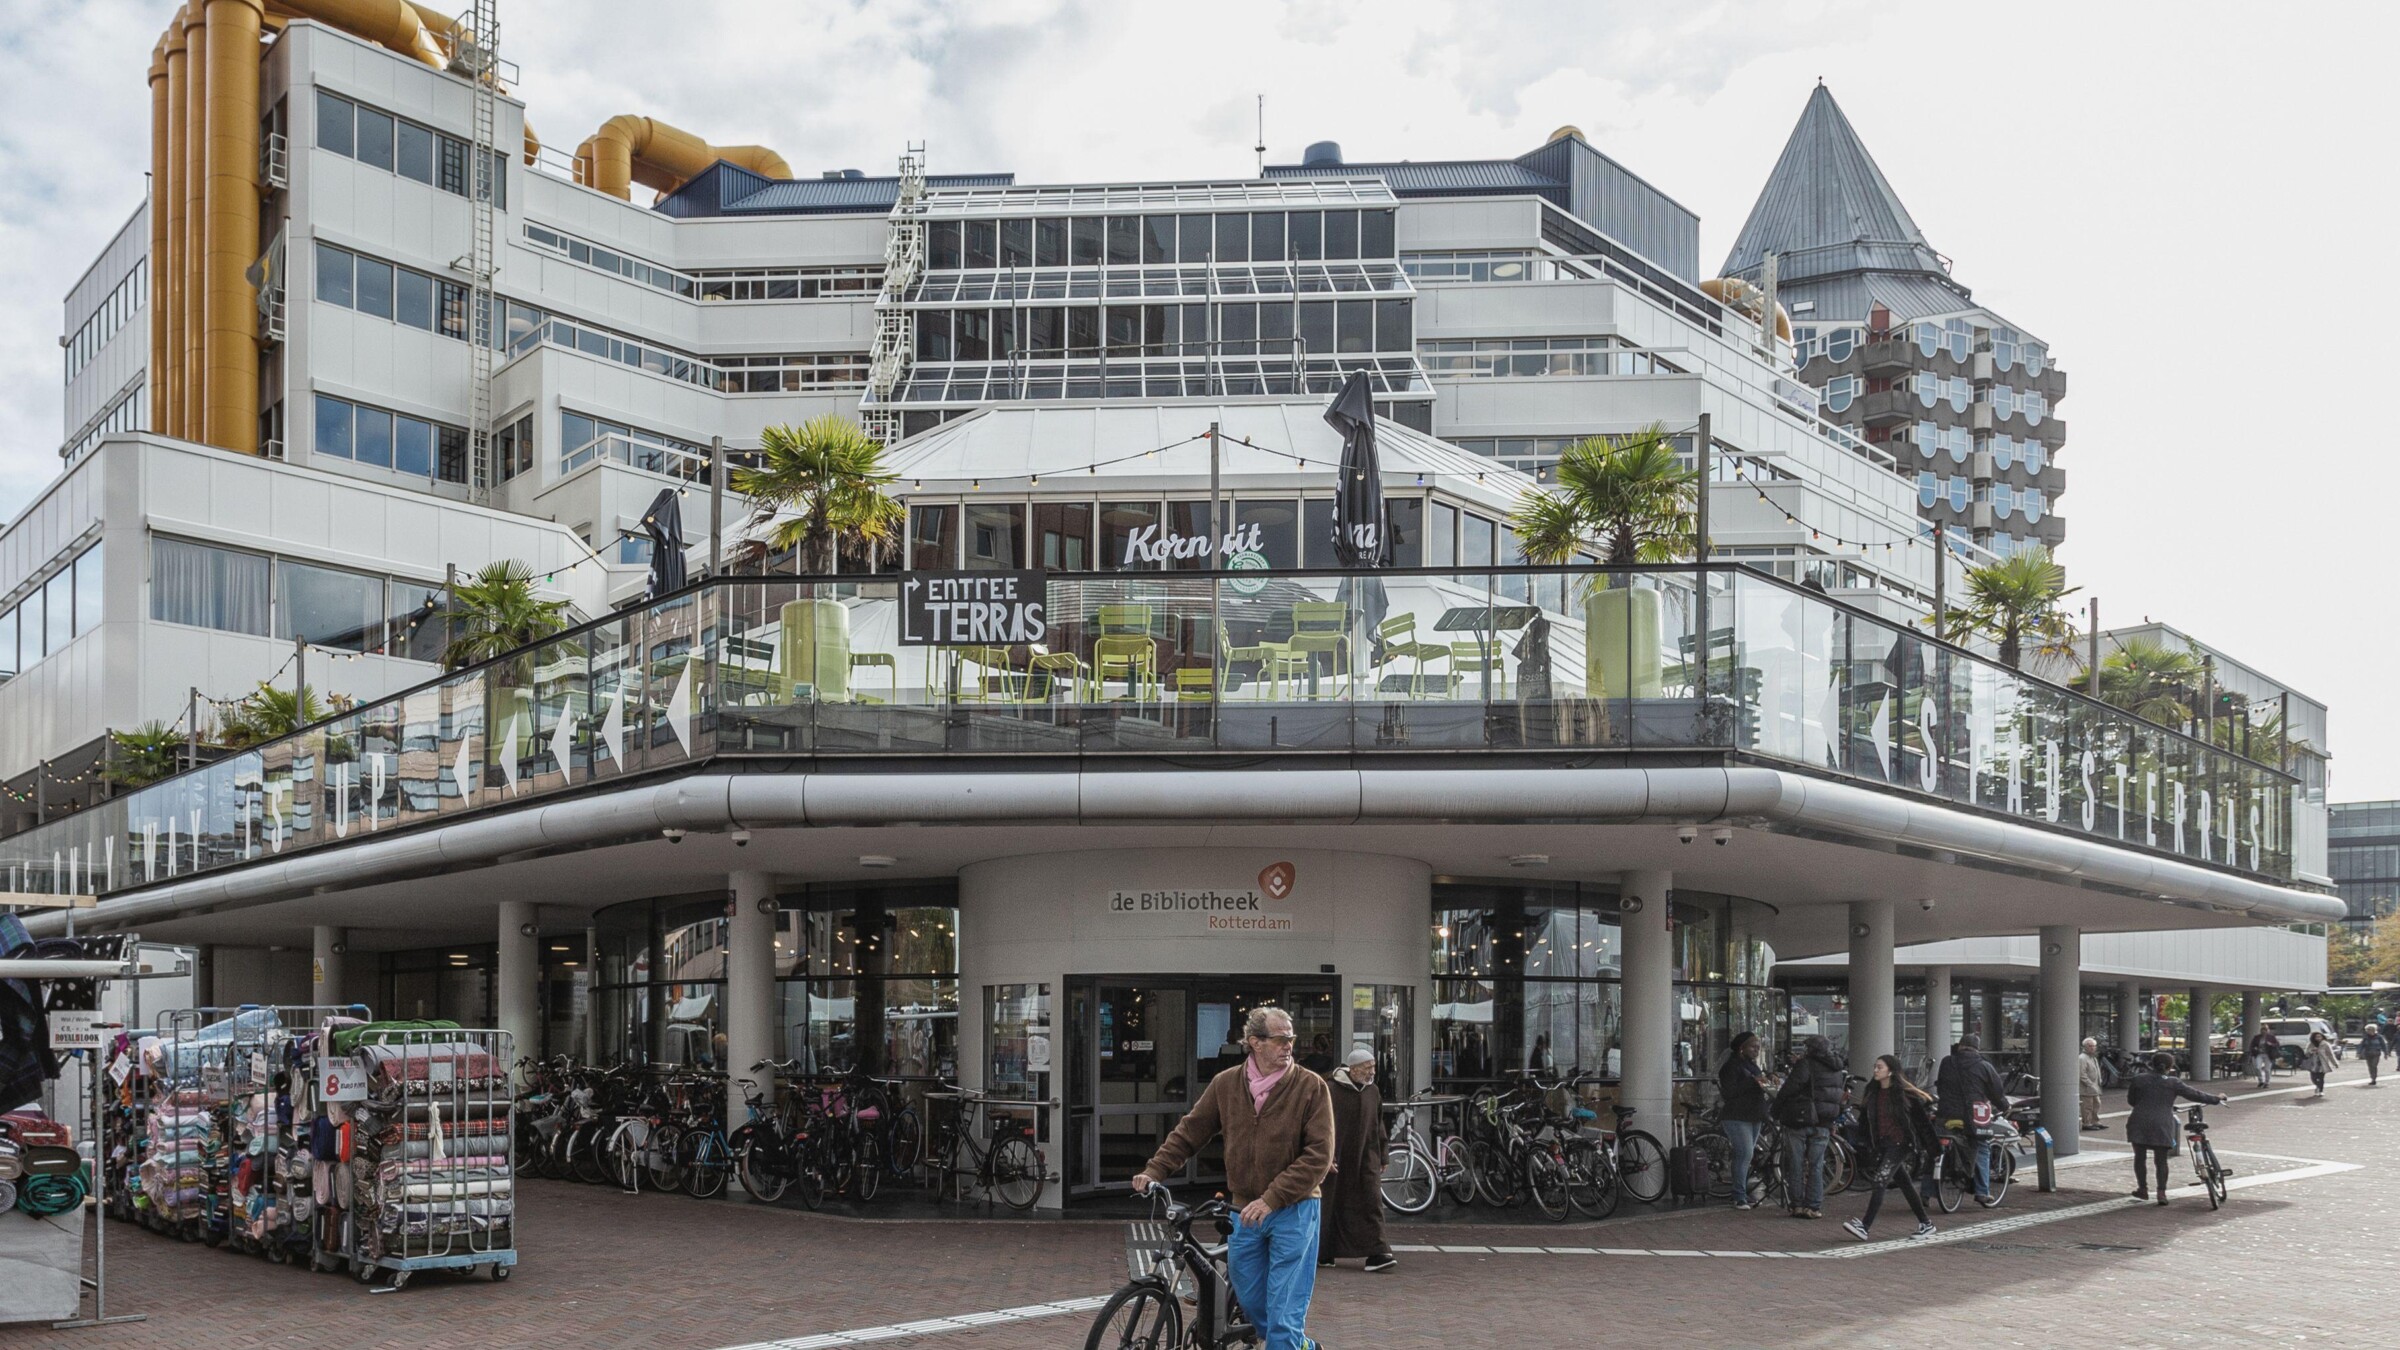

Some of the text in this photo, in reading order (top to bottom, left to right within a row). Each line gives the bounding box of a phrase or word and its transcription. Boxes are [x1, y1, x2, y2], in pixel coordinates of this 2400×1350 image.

[924, 602, 1045, 642] TERRAS
[1920, 697, 2260, 872] STADSTERRAS
[143, 808, 202, 882] WAY
[245, 781, 283, 860] IS
[336, 752, 386, 838] UP
[1110, 891, 1260, 911] de Bibliotheek
[1208, 915, 1292, 930] Rotterdam
[325, 1073, 340, 1096] 8
